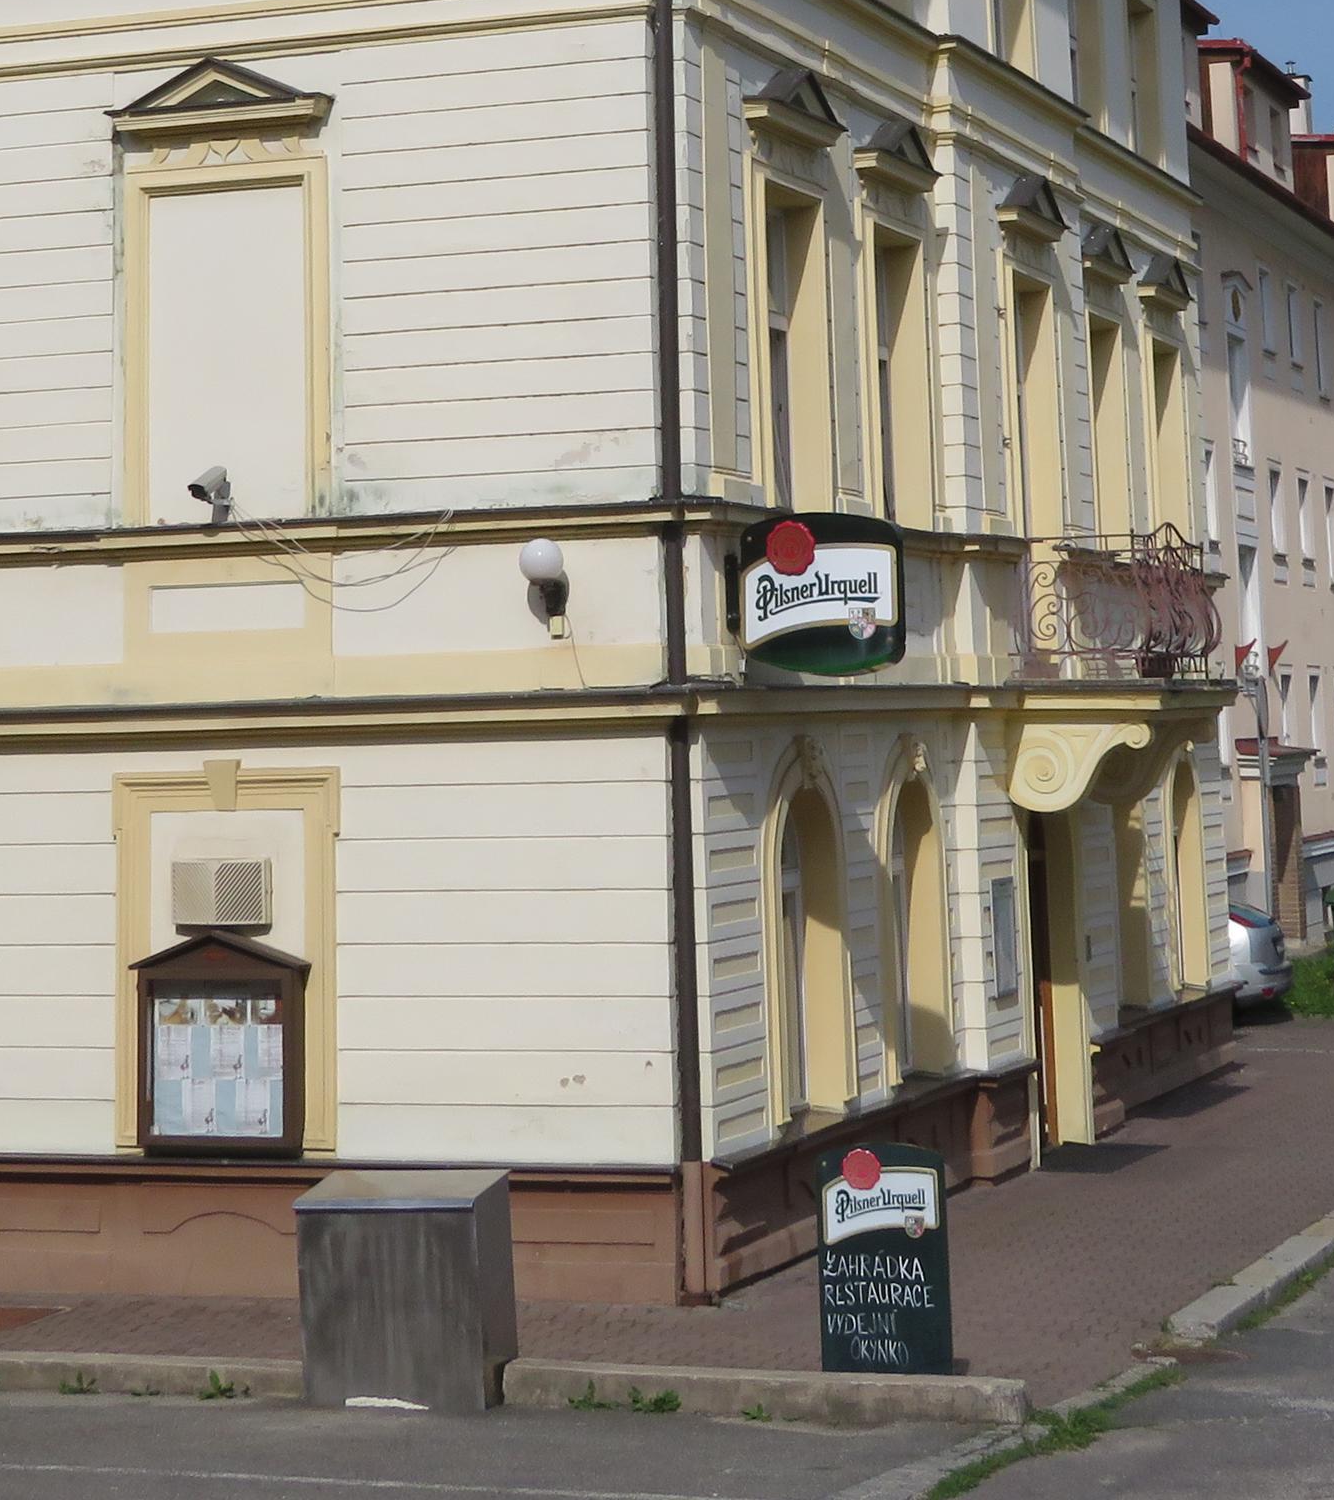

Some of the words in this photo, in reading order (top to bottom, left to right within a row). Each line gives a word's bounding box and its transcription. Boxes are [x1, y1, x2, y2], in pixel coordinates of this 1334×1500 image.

[754, 573, 816, 622] Pilsner
[815, 570, 879, 606] Urquell
[835, 1189, 881, 1224] Pilsner
[880, 1187, 926, 1212] Urquell
[824, 1281, 935, 1308] RESTAURACE
